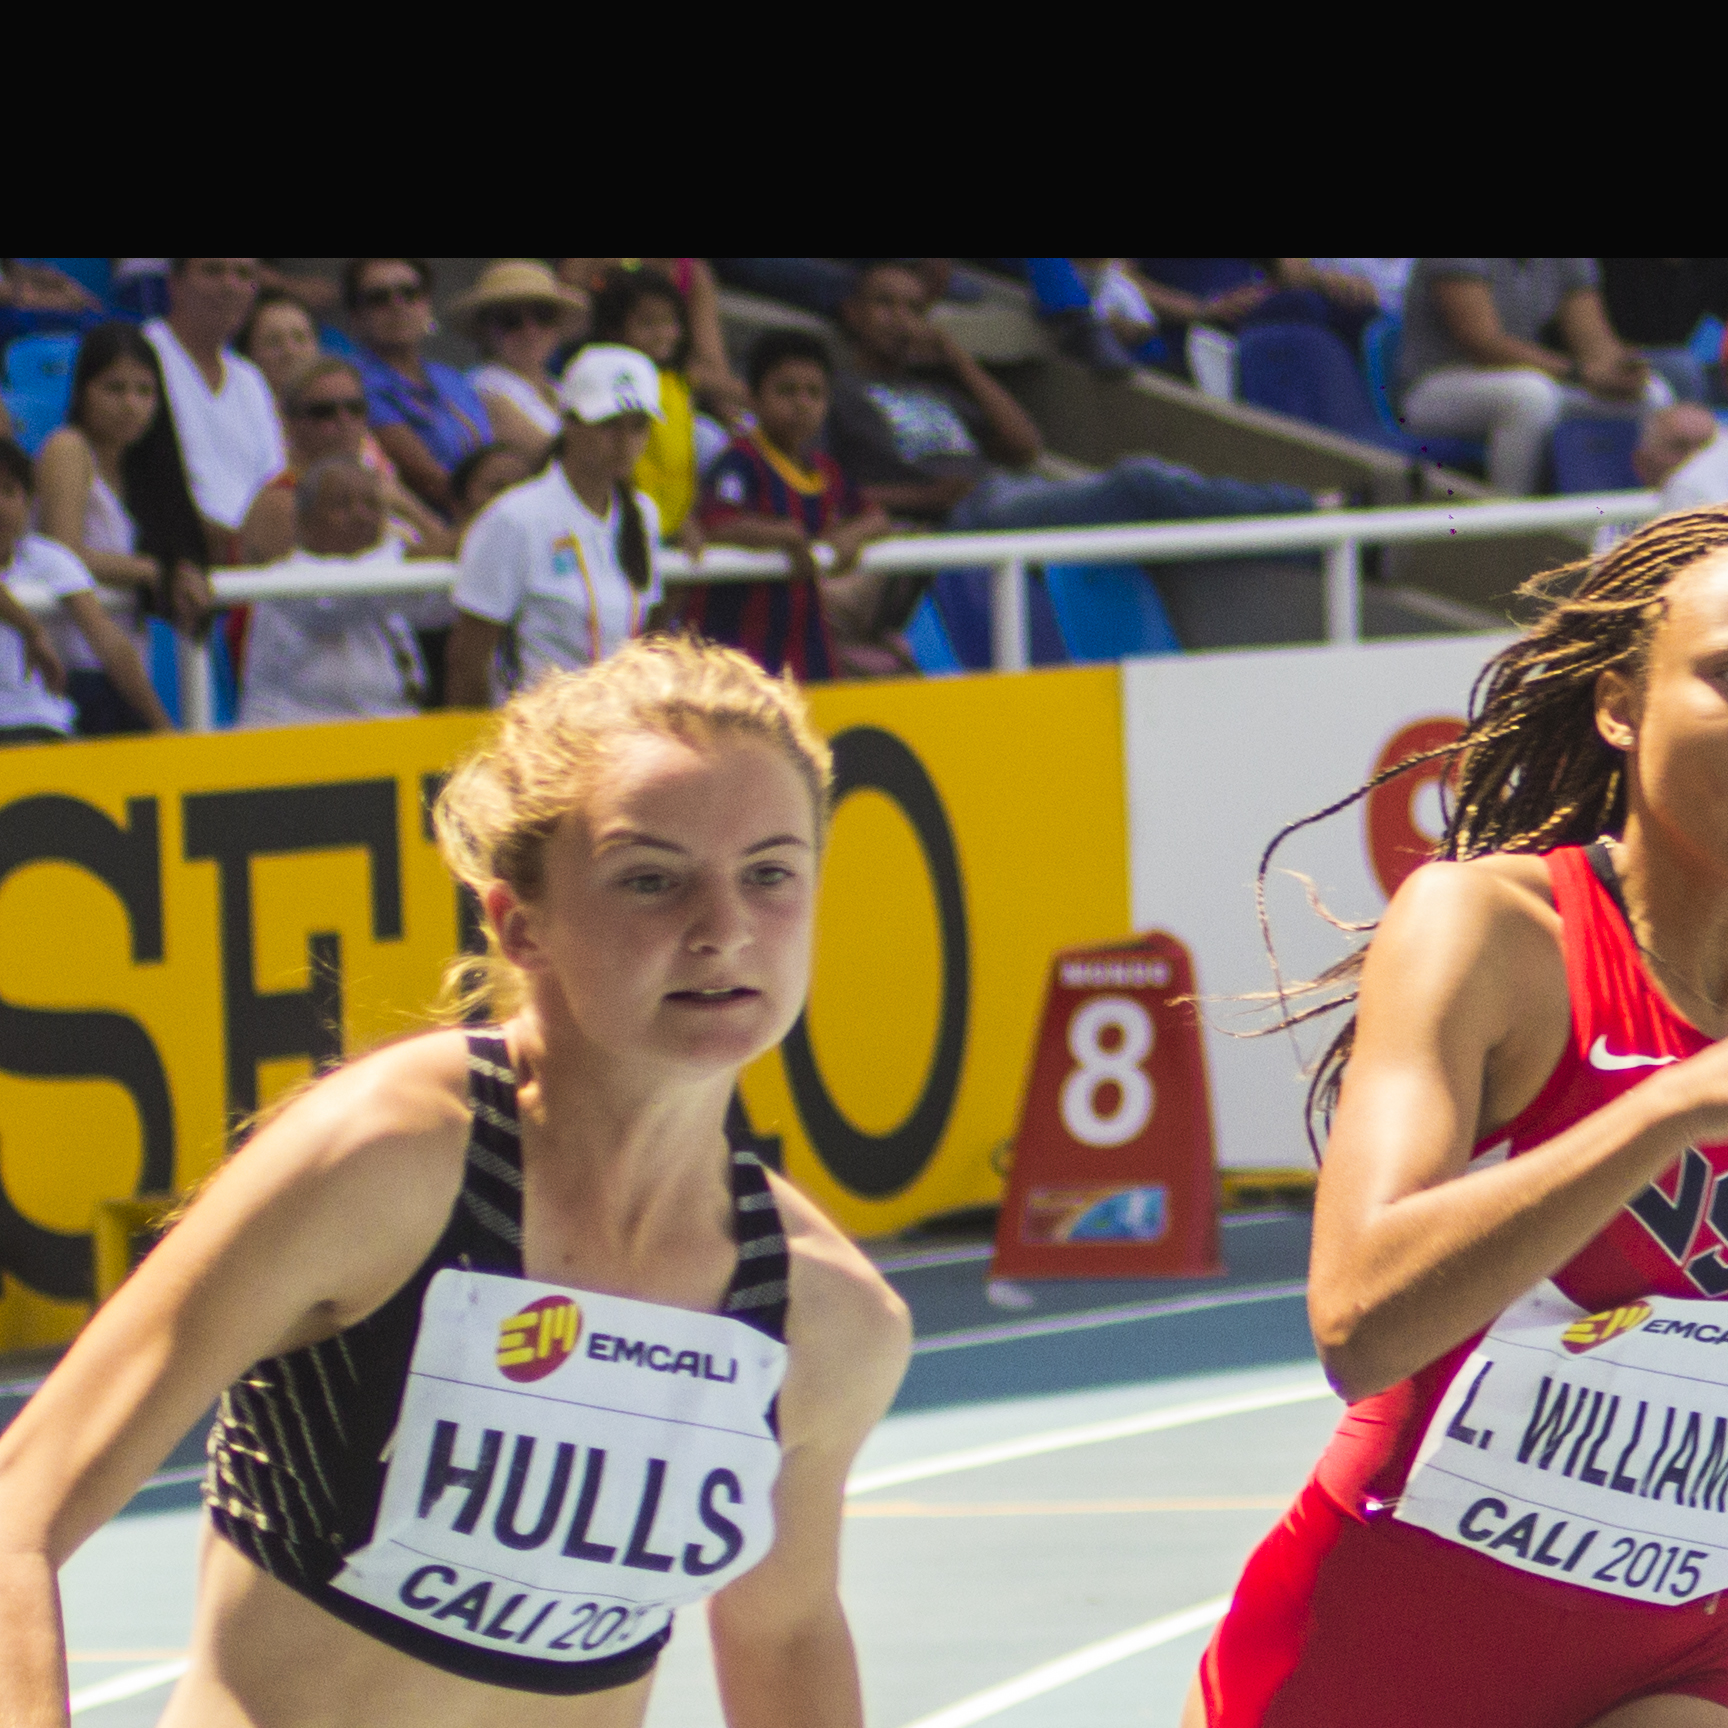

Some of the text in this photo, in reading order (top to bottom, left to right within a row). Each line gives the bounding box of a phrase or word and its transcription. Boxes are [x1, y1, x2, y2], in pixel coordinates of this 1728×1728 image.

[1059, 998, 1155, 1149] 8
[586, 1332, 739, 1384] EMCALI
[1446, 1360, 1496, 1451] L.
[416, 1418, 745, 1577] HULLS
[1456, 1497, 1710, 1598] CALI 2015
[398, 1563, 561, 1644] CALI
